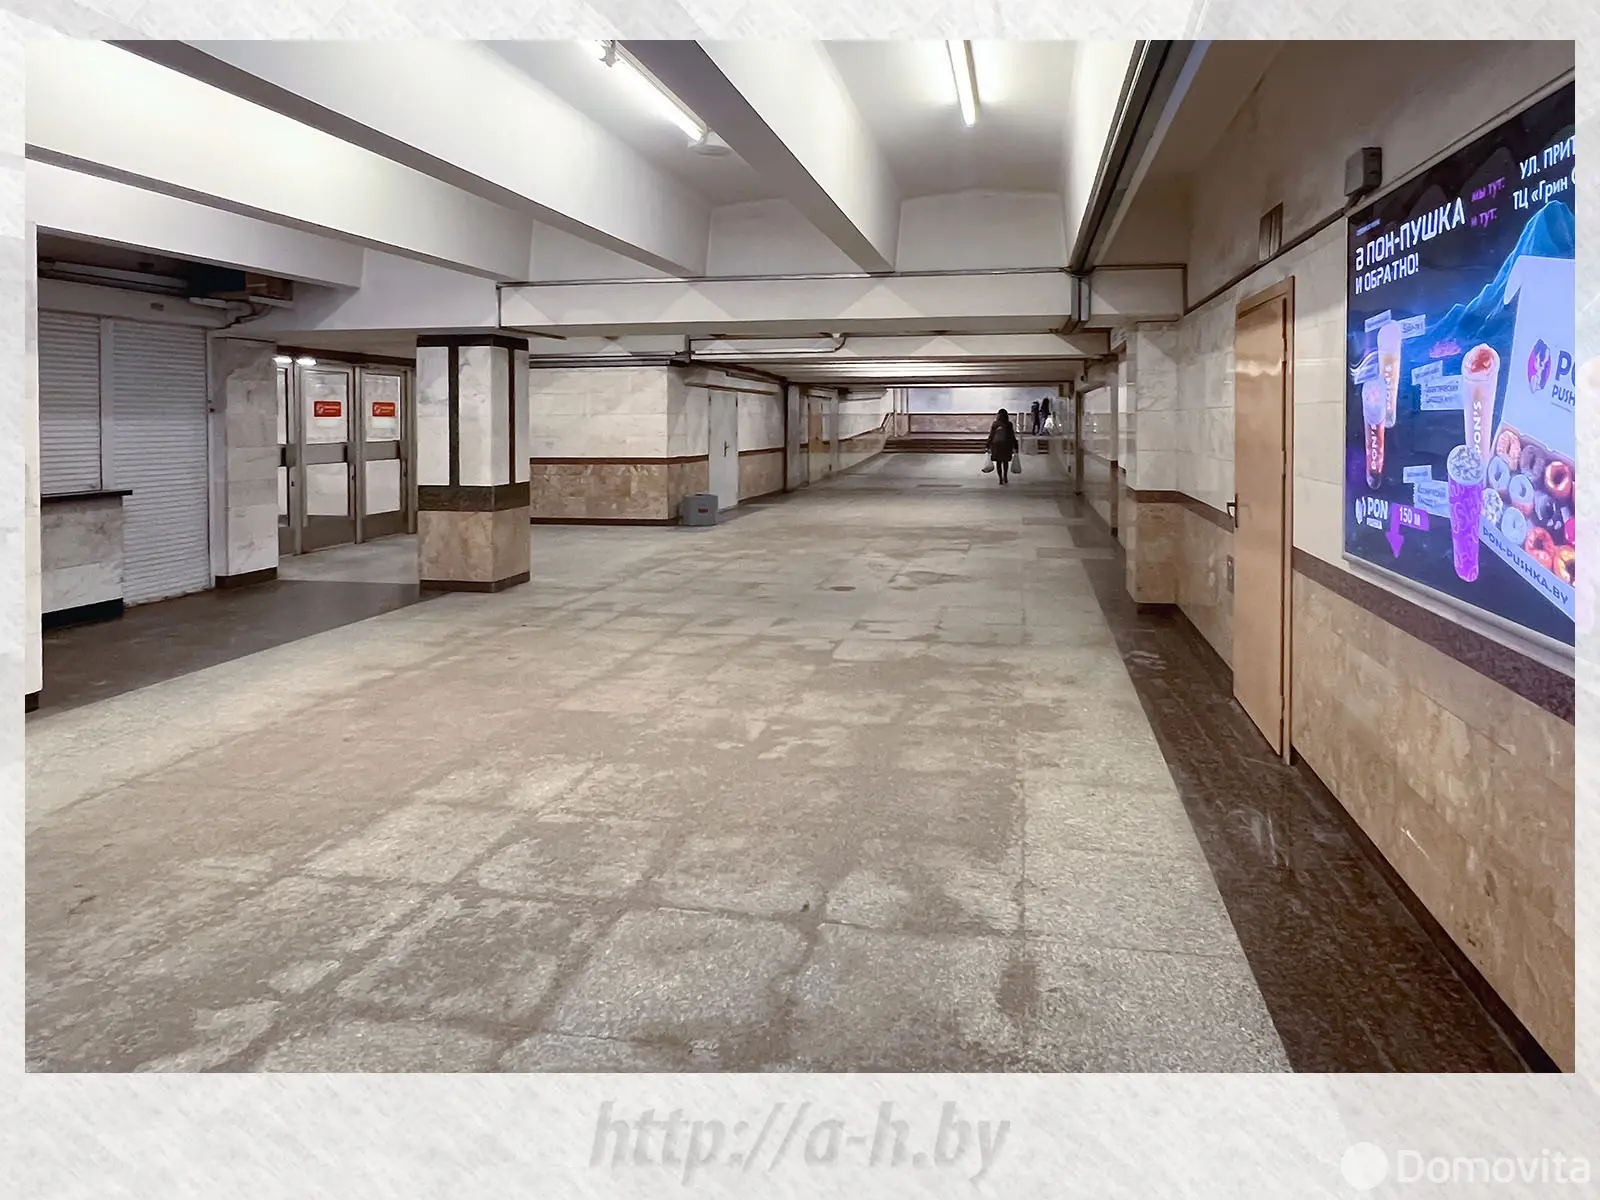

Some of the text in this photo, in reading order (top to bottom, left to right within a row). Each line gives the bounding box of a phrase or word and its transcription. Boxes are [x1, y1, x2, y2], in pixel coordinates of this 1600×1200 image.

[1520, 155, 1540, 180] УЛ.
[1513, 176, 1568, 210] ТЦ «Грин
[1366, 196, 1466, 266] ПОН-ПУШКА
[1355, 252, 1419, 295] И ОБРАТНО!
[1367, 497, 1388, 520] PON
[1400, 506, 1413, 524] 150
[1482, 526, 1569, 604] PON-PUSHKA.BY
